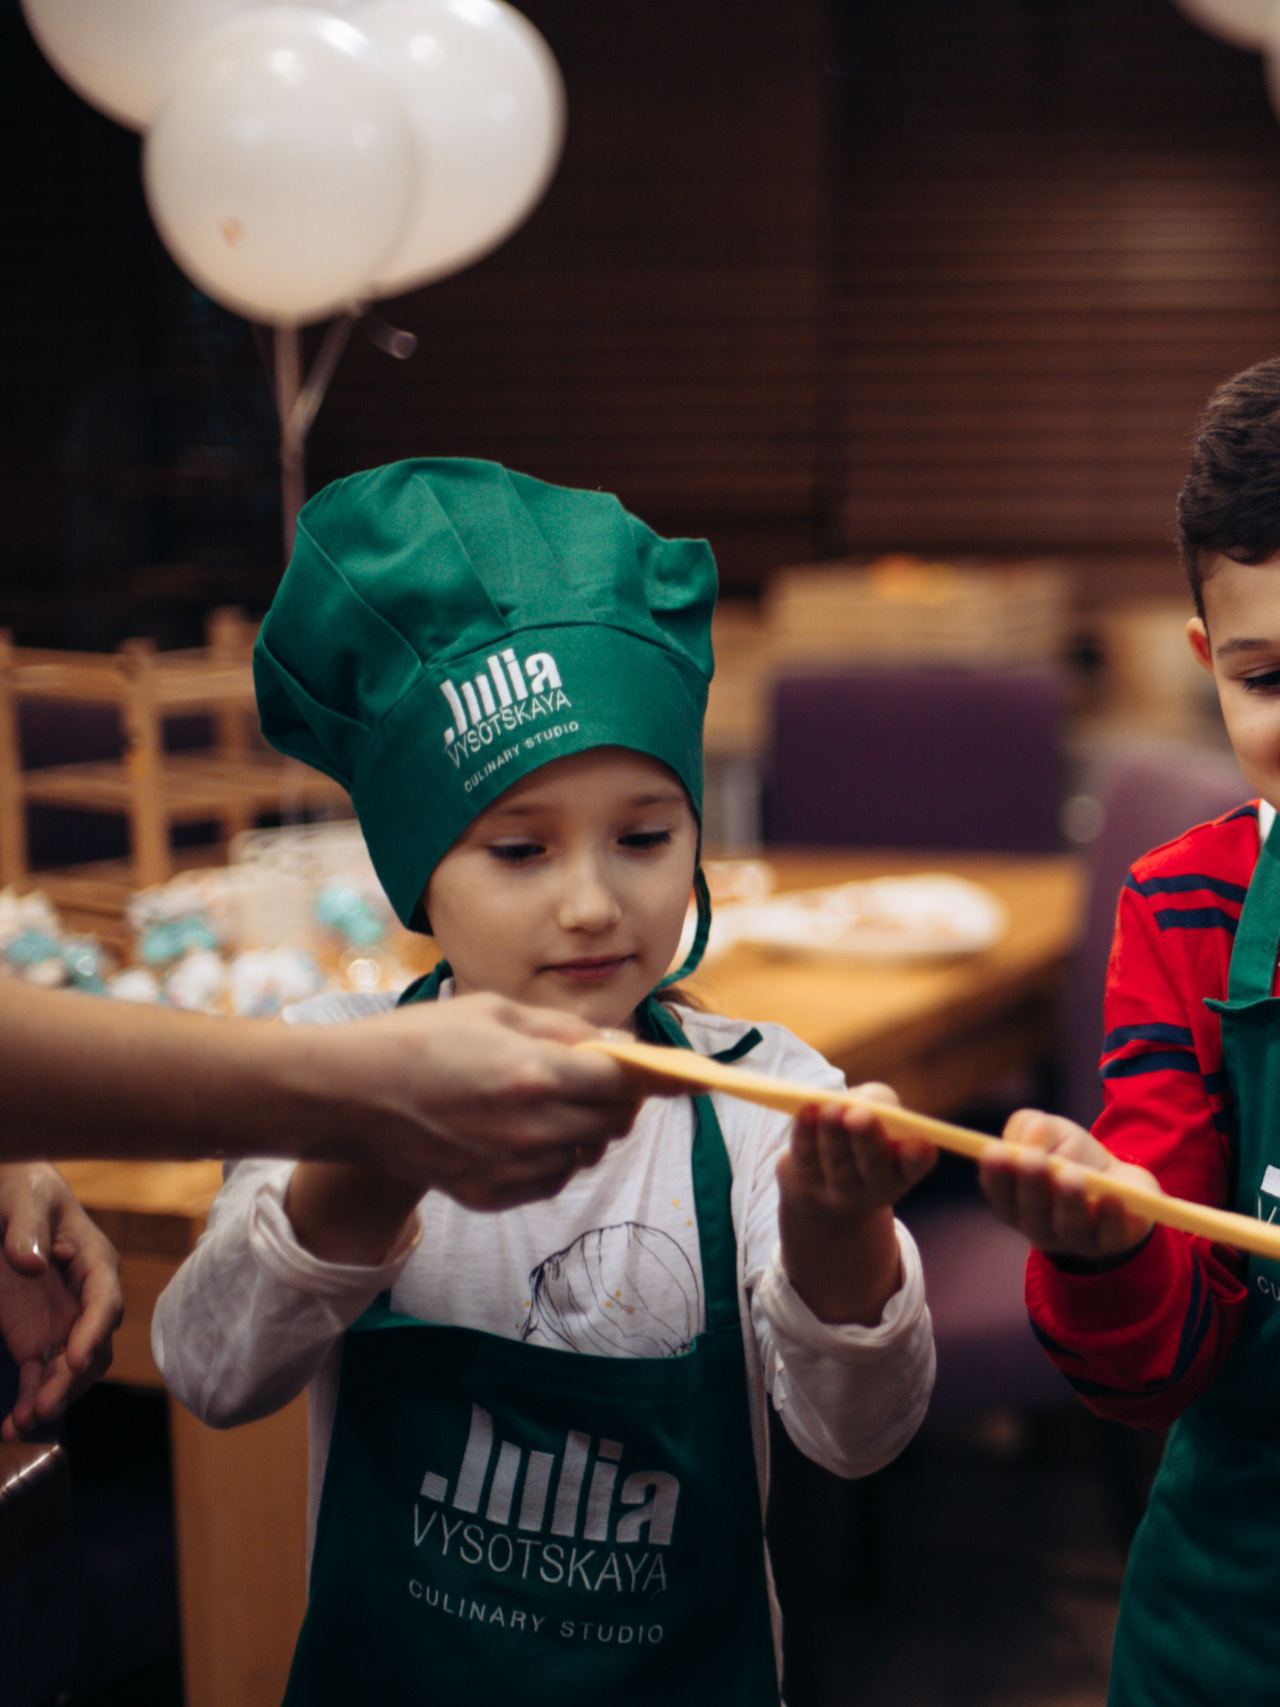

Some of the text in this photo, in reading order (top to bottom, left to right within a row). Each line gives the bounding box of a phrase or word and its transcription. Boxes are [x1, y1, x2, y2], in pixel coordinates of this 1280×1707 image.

[440, 647, 563, 746] Julia
[444, 688, 573, 769] VYSOTSKAYA
[463, 720, 580, 793] CULINARY STUDIO
[419, 1402, 681, 1546] Julia
[412, 1503, 669, 1593] VYSOTSKAYA
[408, 1578, 664, 1645] CULINARY STUDIO
